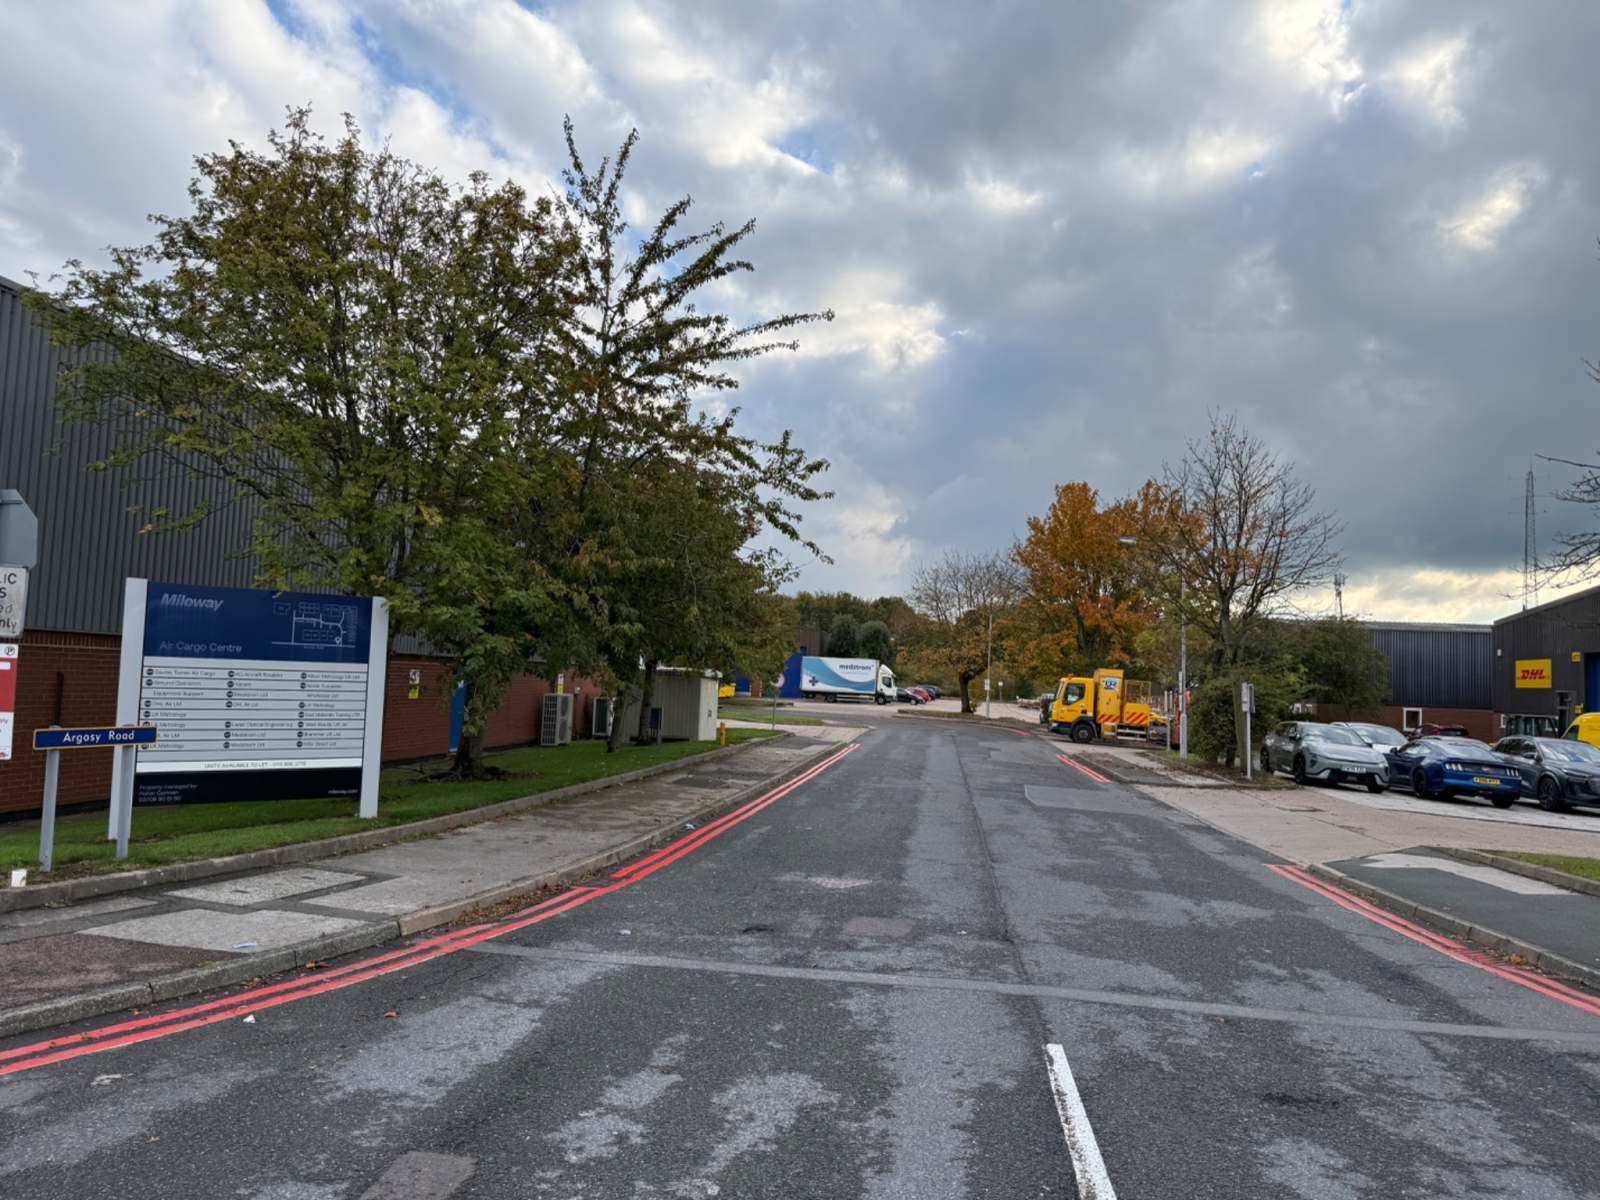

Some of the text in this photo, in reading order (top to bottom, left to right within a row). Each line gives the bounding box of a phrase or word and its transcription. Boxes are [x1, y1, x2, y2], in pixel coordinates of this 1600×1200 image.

[175, 640, 208, 654] Cargo
[209, 642, 243, 653] Centre
[1520, 669, 1546, 680] DHL
[62, 730, 135, 744] Argosy Road
